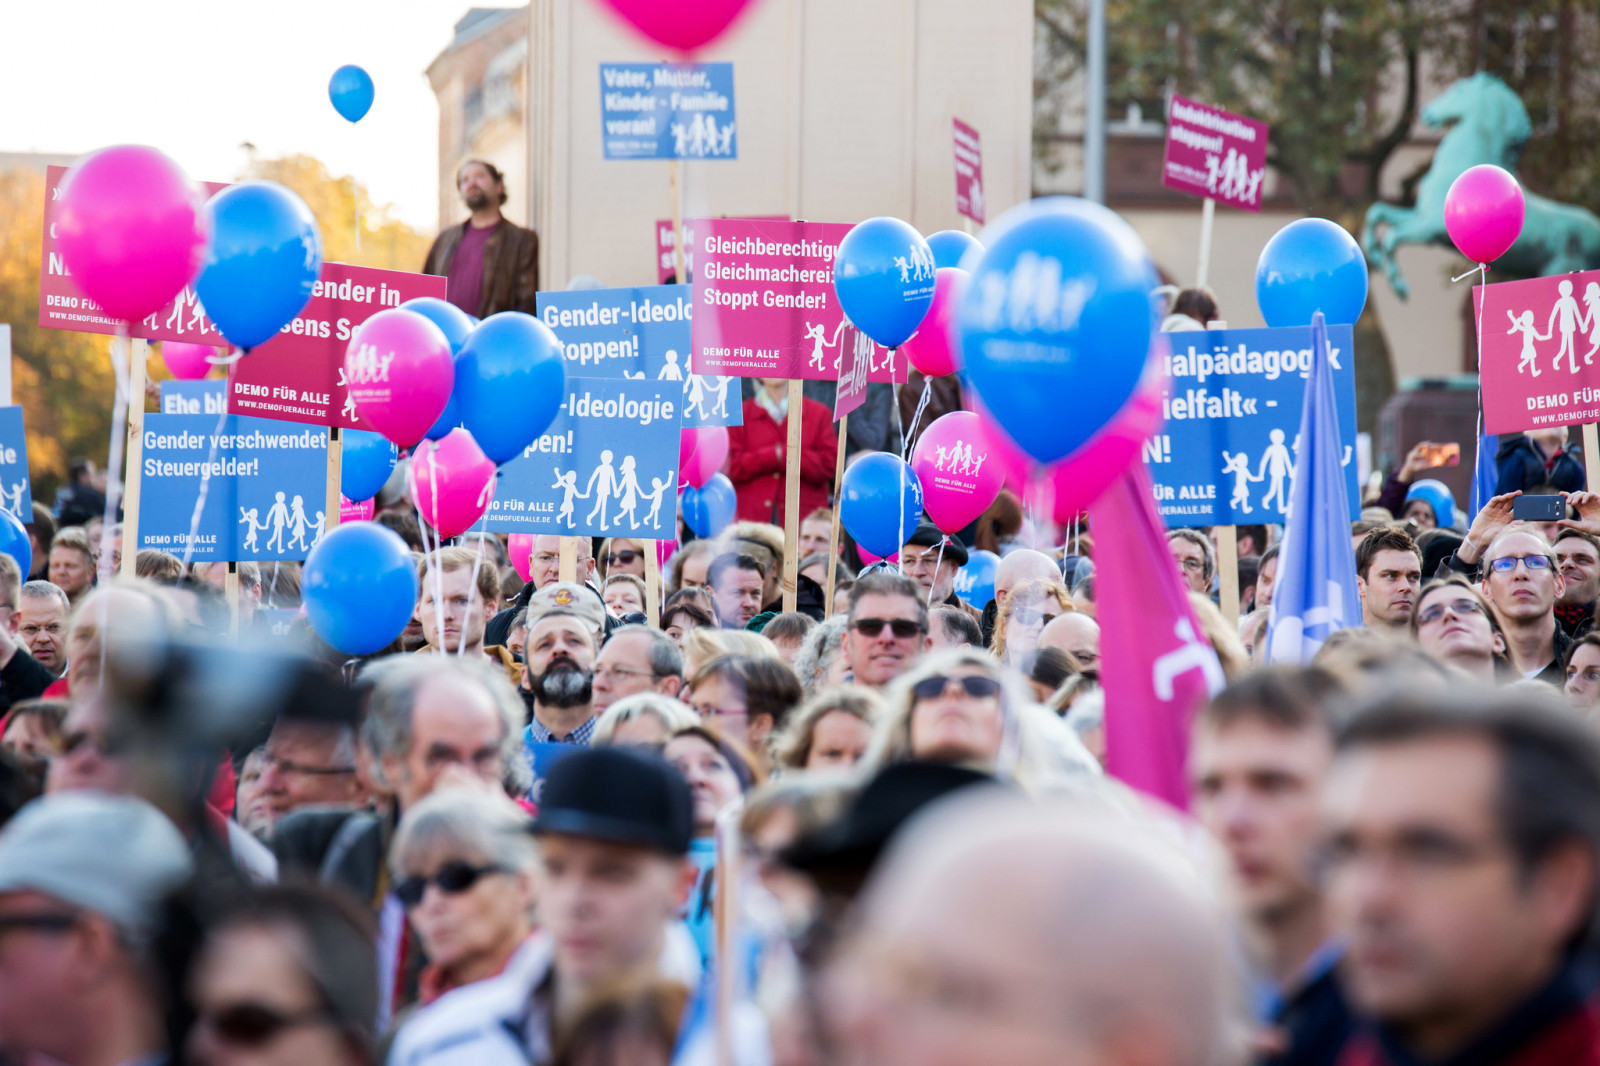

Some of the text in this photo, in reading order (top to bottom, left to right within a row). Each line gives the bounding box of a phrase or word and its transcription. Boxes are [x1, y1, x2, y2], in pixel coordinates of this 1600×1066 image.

[603, 68, 711, 90] Vater, Mutter,
[605, 91, 656, 111] Kinder
[670, 91, 728, 111] Familie
[606, 117, 656, 136] voran!
[47, 295, 78, 309] DEMO
[311, 279, 400, 306] ender in
[704, 288, 826, 310] Stoppt Gender!
[543, 297, 693, 328] Gender-Ideolo
[280, 318, 331, 338] sens
[558, 334, 639, 366] toppen!
[703, 346, 780, 358] DEMO FÜR ALLE
[705, 360, 777, 368] WWW.DEMOFUERALLE.DE
[164, 393, 201, 414] Ehe
[235, 383, 330, 405] DEMO FÜR ALLE
[1162, 388, 1258, 420] ielfalt«
[1526, 393, 1569, 411] DEMO
[237, 400, 327, 417] WWW.DEMOFUERALLE.DE
[560, 392, 674, 425] -Ideologie
[144, 430, 327, 449] Gender verschwendet
[524, 430, 573, 458] pen!
[144, 457, 259, 481] Steuergelder!
[1153, 484, 1216, 500] ÜR ALLE
[503, 499, 525, 511] FÜR
[528, 502, 554, 512] ALLE
[144, 535, 171, 544] DEMO
[194, 535, 217, 544] ALLE
